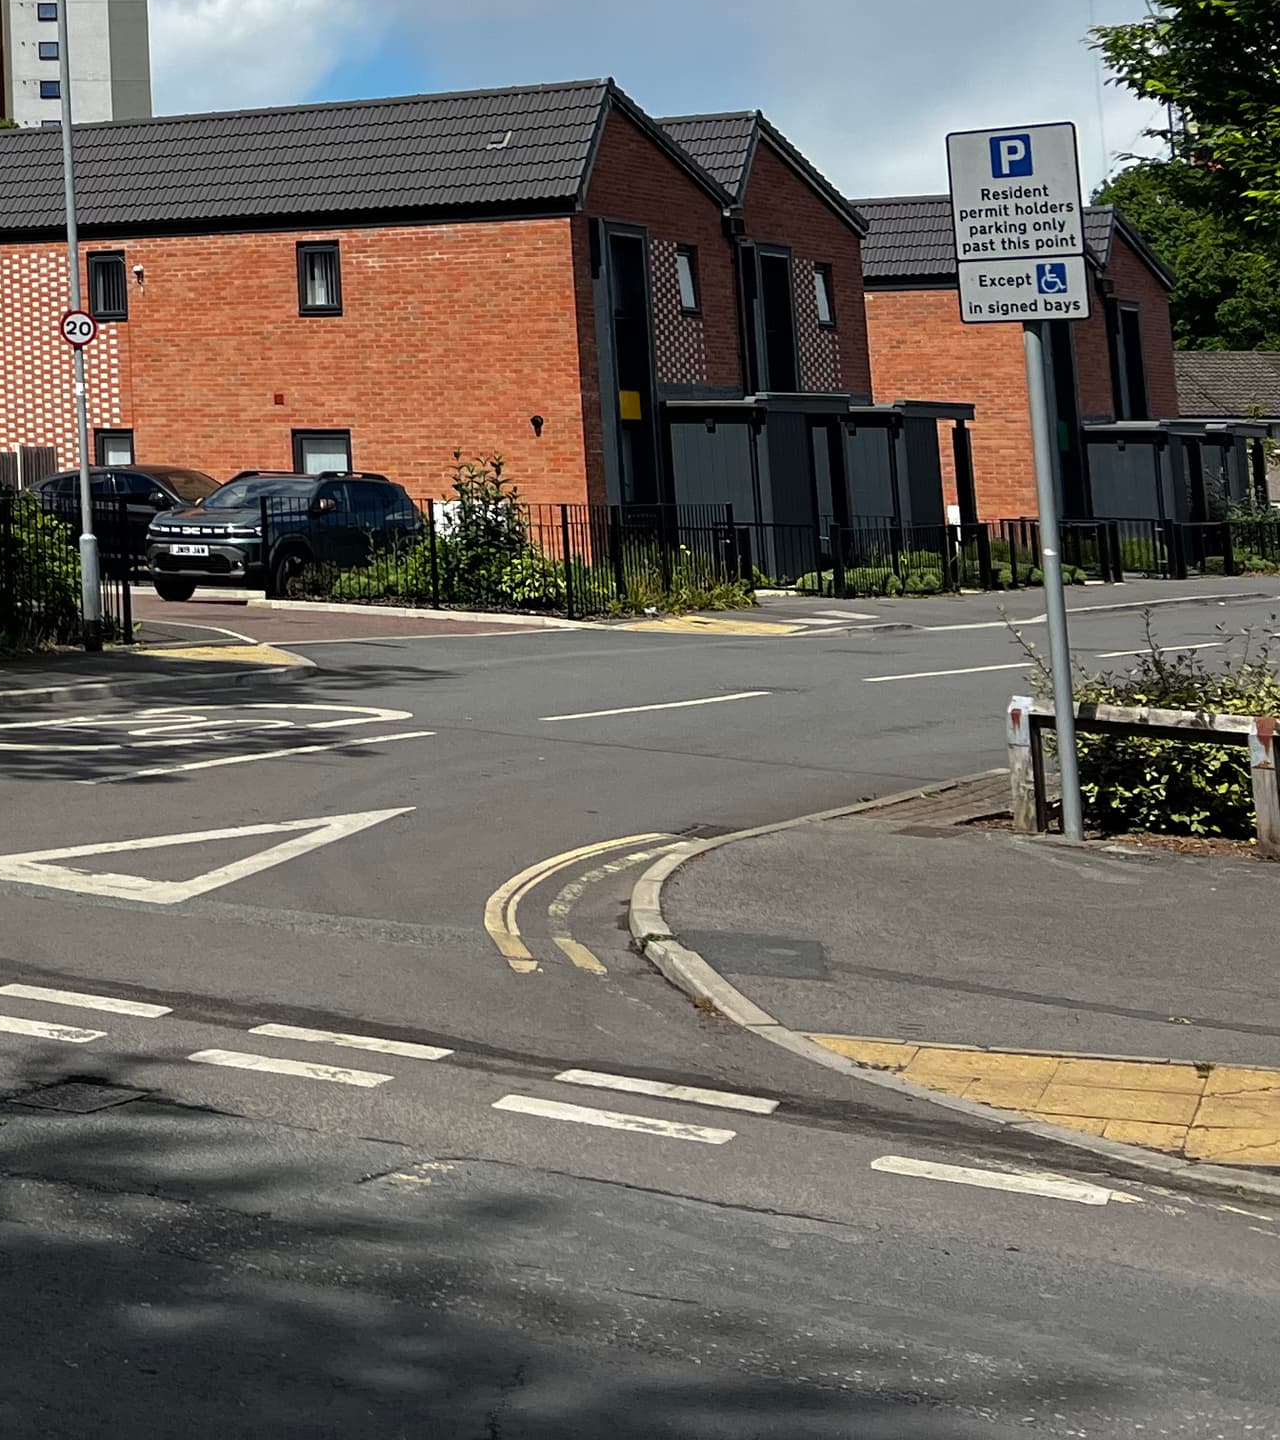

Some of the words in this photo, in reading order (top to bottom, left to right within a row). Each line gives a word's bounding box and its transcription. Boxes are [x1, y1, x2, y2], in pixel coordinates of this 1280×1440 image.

[999, 139, 1025, 174] P
[981, 184, 1049, 201] Resident
[959, 203, 1009, 221] permit
[1015, 201, 1074, 215] holders
[969, 220, 1027, 238] parking
[1033, 218, 1066, 234] only
[962, 239, 995, 255] past
[1001, 236, 1030, 250] this
[1036, 234, 1076, 250] point
[979, 273, 1032, 290] Except
[969, 302, 983, 314] in
[988, 299, 1038, 316] signed
[1044, 298, 1081, 314] bays
[66, 321, 91, 336] 20
